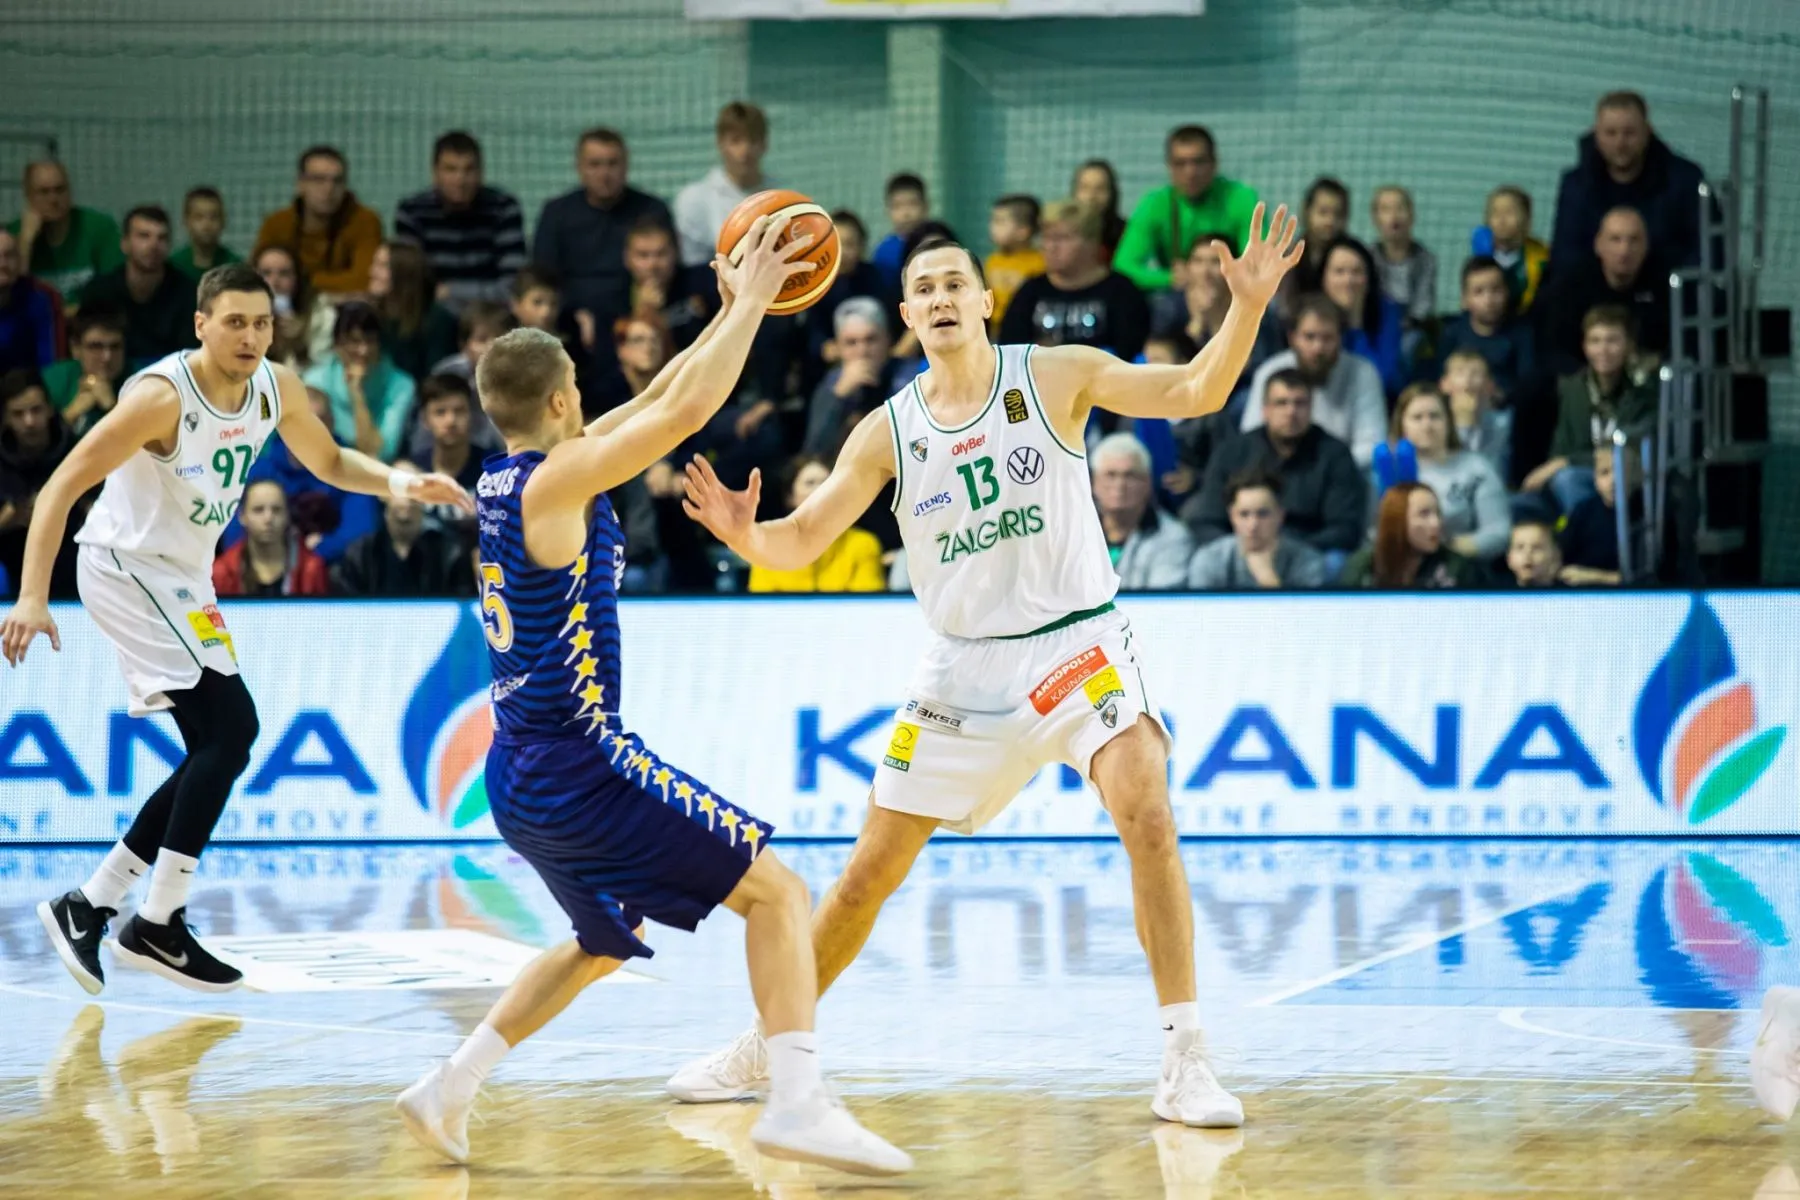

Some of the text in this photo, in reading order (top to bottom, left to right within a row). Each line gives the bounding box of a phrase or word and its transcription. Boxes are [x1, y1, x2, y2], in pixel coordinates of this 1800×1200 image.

[212, 444, 253, 488] 97
[951, 434, 986, 456] OlyBet
[956, 456, 1000, 511] 13
[479, 562, 514, 653] 5
[1035, 650, 1097, 700] AKROPOLIS
[1050, 667, 1092, 703] KAUNAS
[795, 703, 1610, 791] KANA
